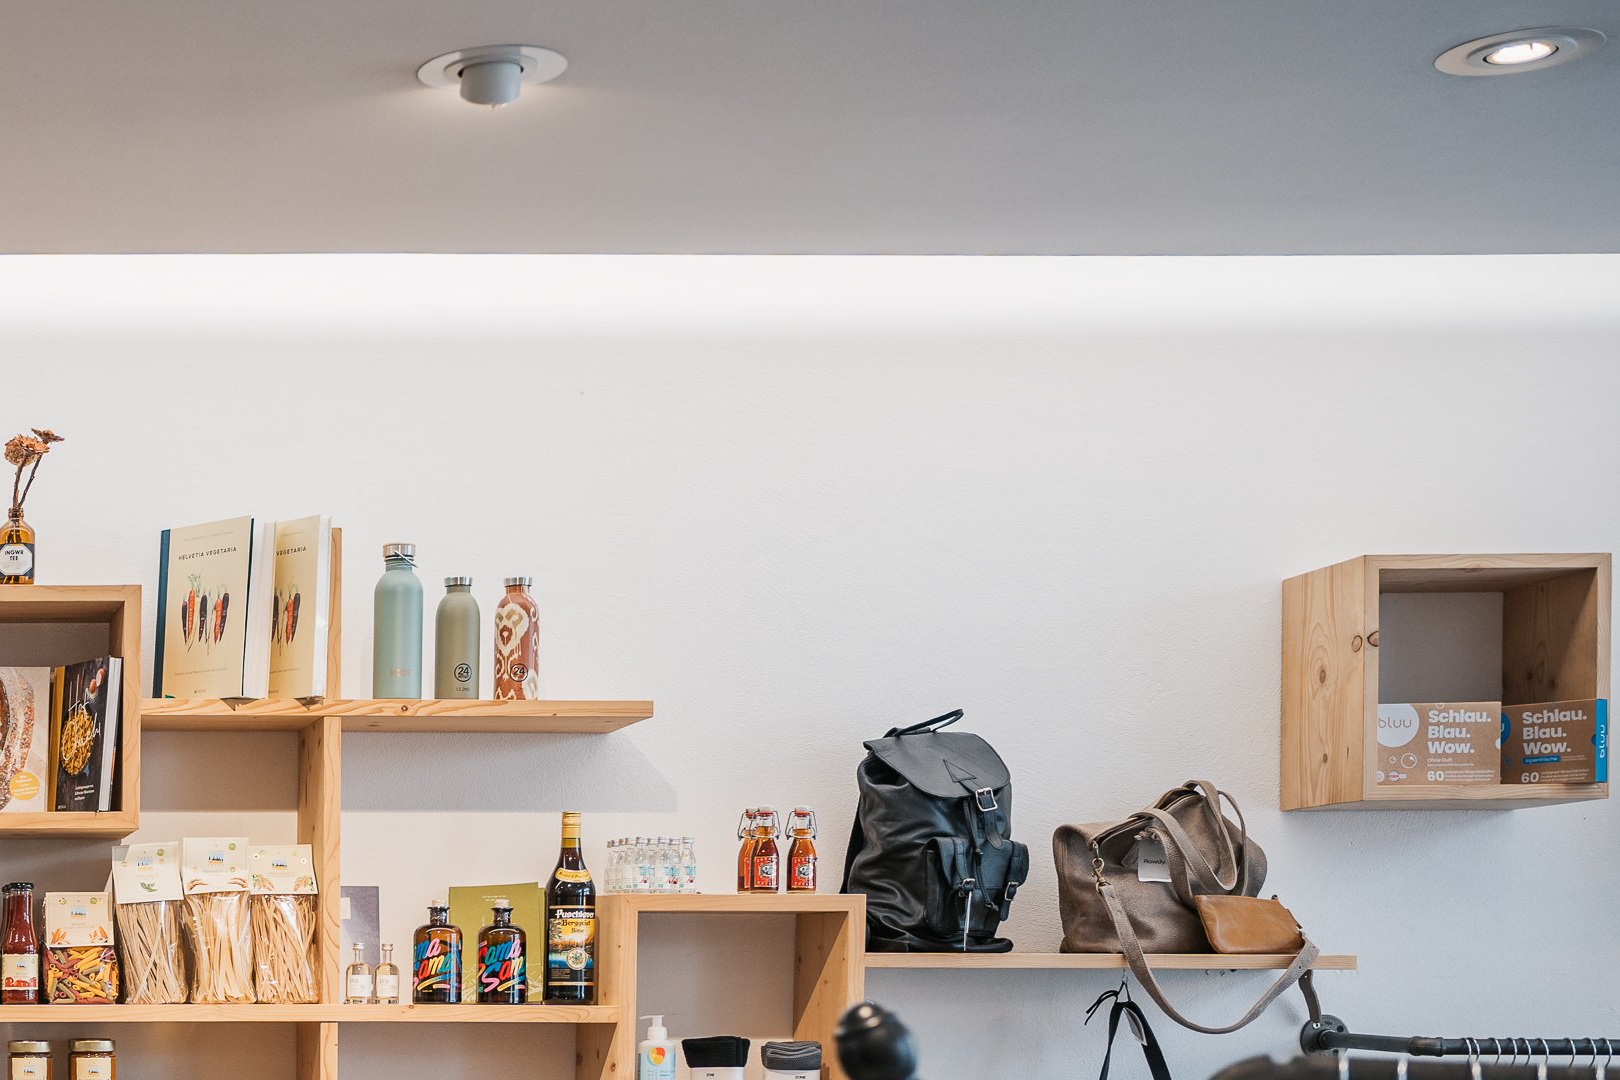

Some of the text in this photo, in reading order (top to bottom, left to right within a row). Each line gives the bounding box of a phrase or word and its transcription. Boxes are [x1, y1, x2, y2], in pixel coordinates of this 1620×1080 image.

[178, 546, 237, 561] HELVETIA VEGETARIA
[276, 546, 307, 557] VEGETARIA
[457, 666, 470, 676] 24
[513, 666, 526, 676] 24
[1378, 716, 1413, 729] bluu
[1428, 709, 1492, 724] Schlau.
[1522, 708, 1587, 725] Schlau.
[1428, 725, 1471, 739] Blau.
[1522, 726, 1567, 740] Blau.
[1427, 741, 1475, 754] Wow.
[1598, 724, 1606, 759] bluu
[1523, 742, 1572, 756] Wow.
[1427, 771, 1444, 782] 60
[1521, 772, 1539, 783] 60
[1143, 858, 1167, 866] Rowdy.
